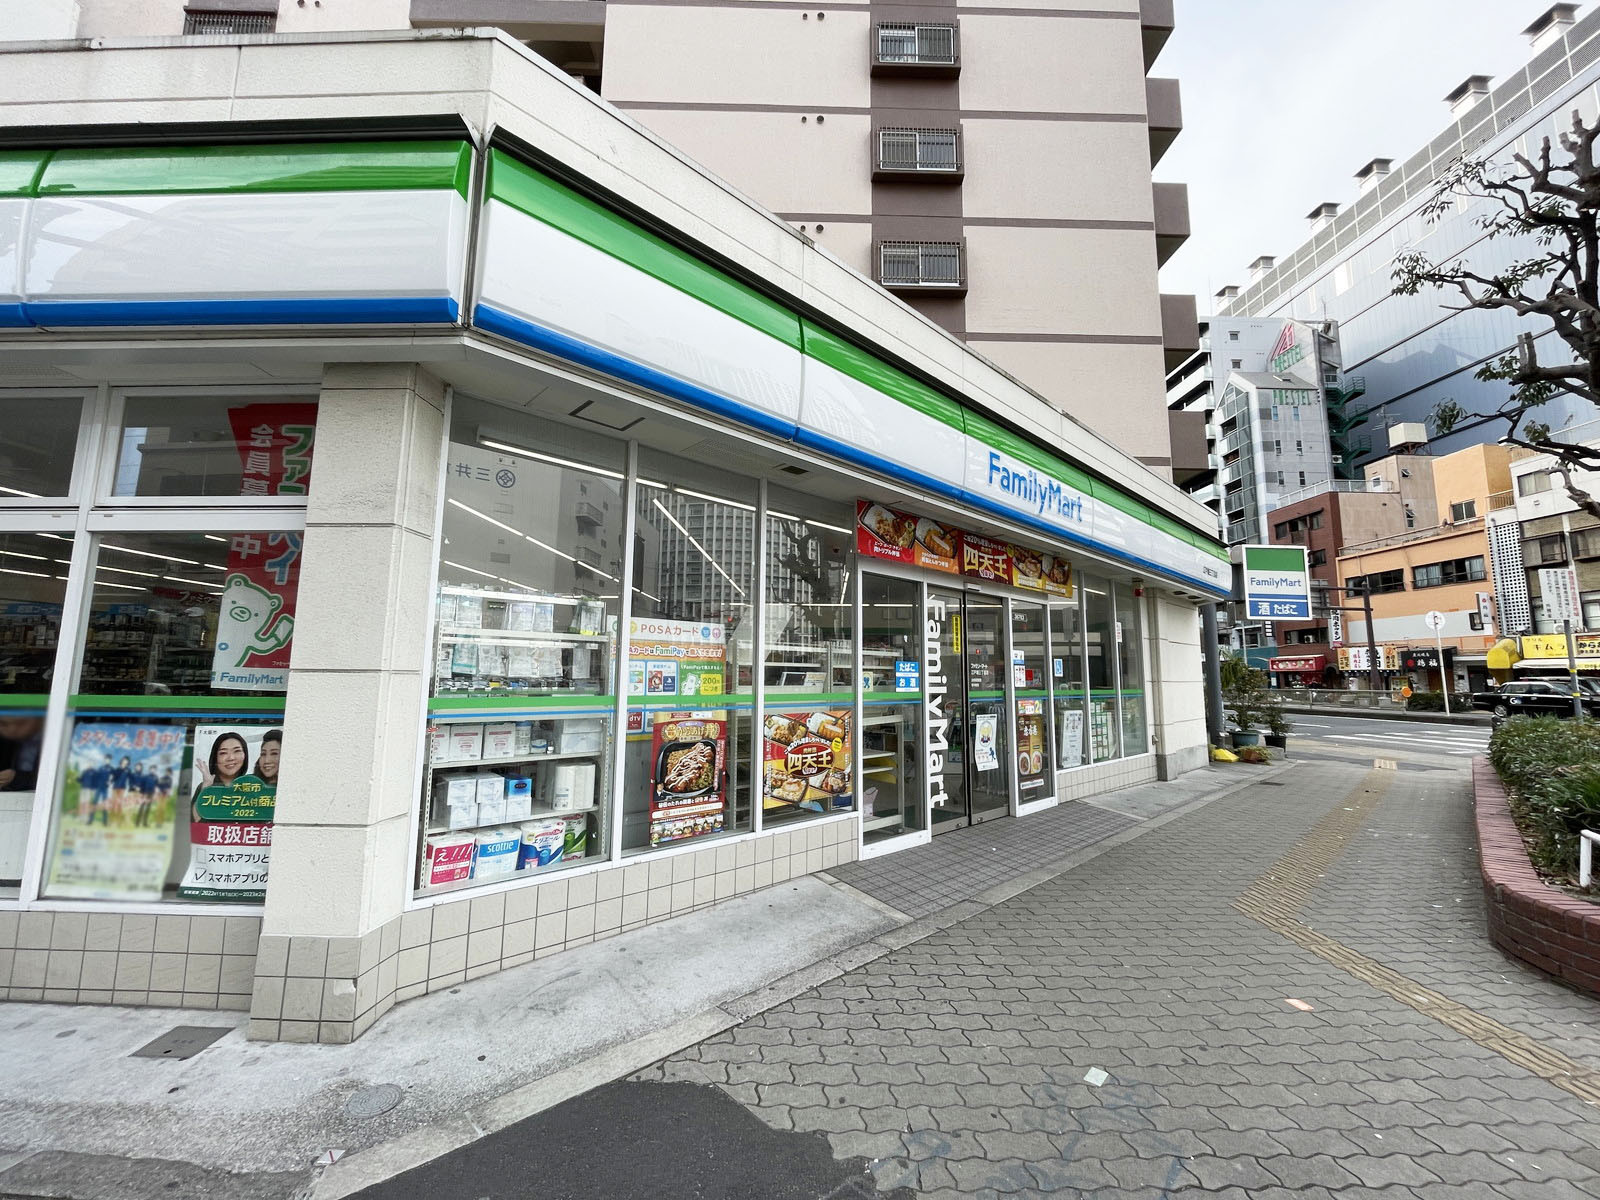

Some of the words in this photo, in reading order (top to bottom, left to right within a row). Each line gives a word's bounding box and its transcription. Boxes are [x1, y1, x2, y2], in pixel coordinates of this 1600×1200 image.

[988, 451, 1083, 522] FamilyMart
[963, 543, 1009, 580] 四天王
[1250, 577, 1302, 588] FamilyMart
[1258, 602, 1271, 615] 酒
[1273, 604, 1299, 615] たばこ
[640, 623, 699, 635] POSAカード
[899, 663, 916, 672] たばこ
[220, 672, 283, 685] FamilyMart
[926, 599, 949, 810] FamilyMart
[787, 748, 832, 774] 四天王
[487, 841, 515, 853] scottie
[208, 853, 269, 864] スマホアプリと
[208, 872, 268, 883] スマホアプリの
